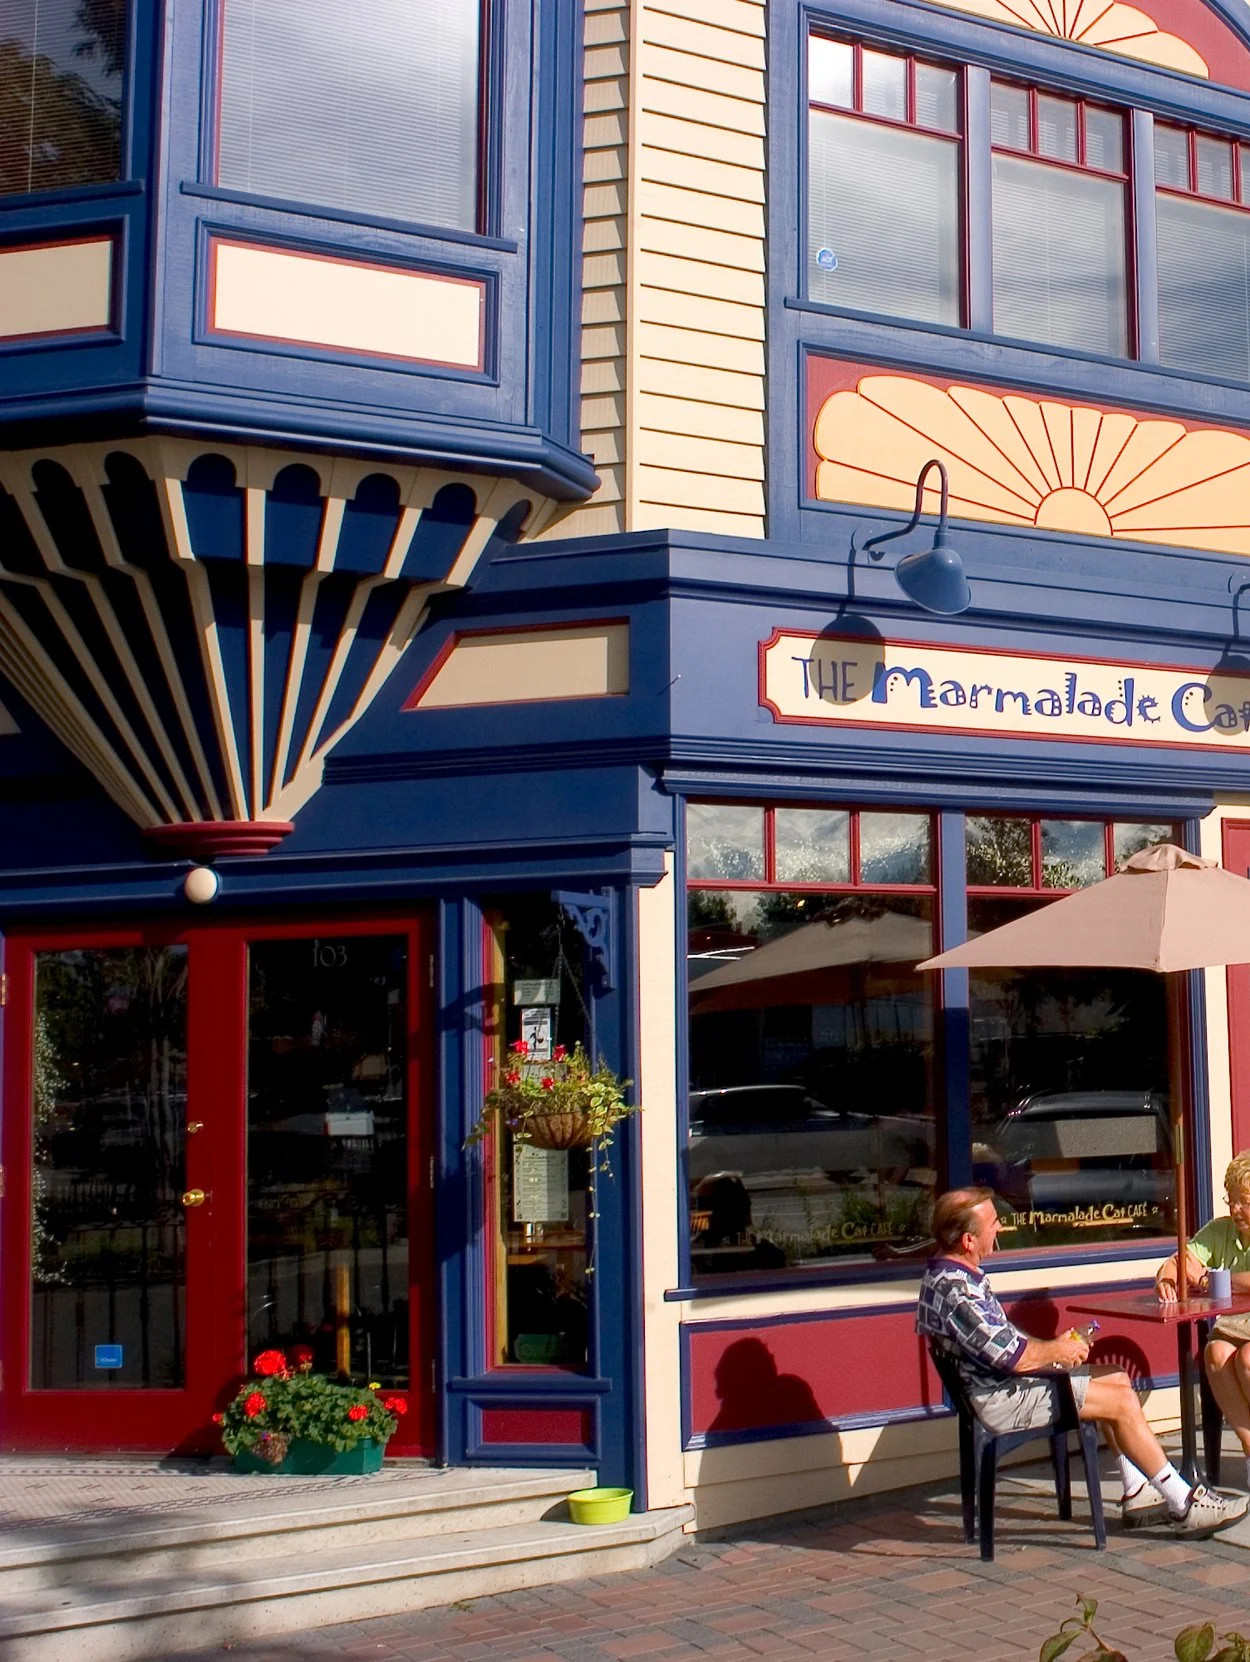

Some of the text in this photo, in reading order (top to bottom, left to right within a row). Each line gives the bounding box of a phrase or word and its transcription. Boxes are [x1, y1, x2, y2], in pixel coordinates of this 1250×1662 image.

[791, 656, 858, 701] THE
[872, 661, 1163, 727] Marmalade
[1011, 1212, 1027, 1226] THE
[1029, 1206, 1100, 1225] Marmalade
[1102, 1204, 1126, 1219] Cat
